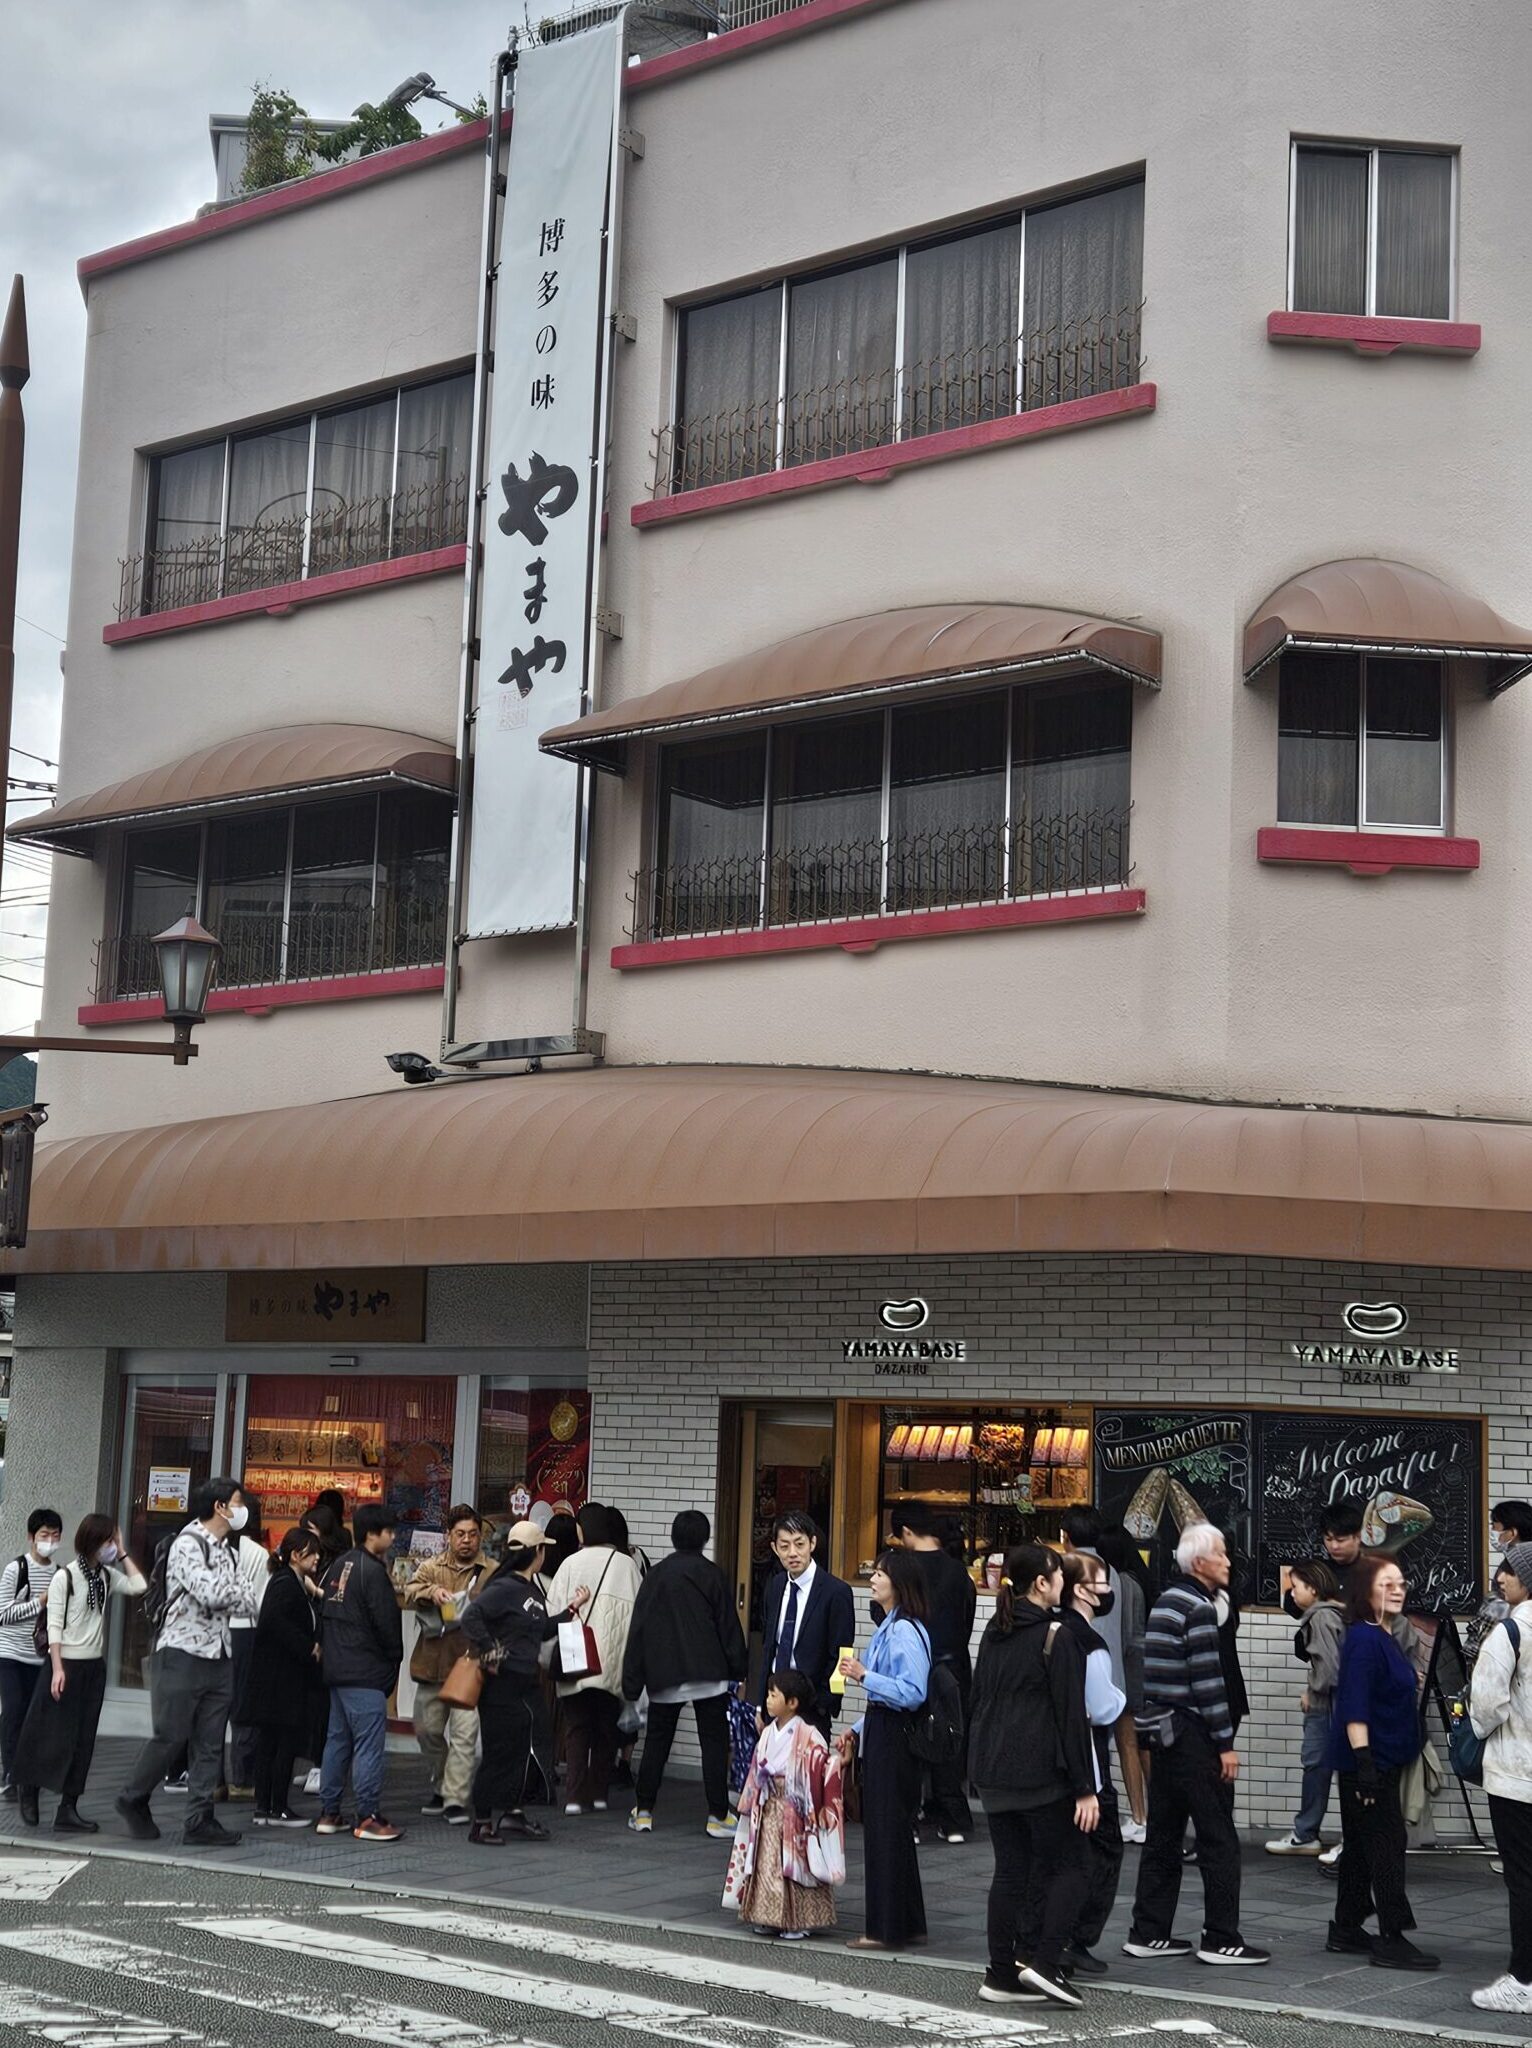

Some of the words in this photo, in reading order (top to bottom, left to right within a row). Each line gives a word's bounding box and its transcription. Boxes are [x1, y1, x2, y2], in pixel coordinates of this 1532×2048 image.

[531, 217, 566, 411] 博多の味
[497, 449, 579, 699] やまや
[313, 1280, 390, 1321] やまや
[841, 1340, 914, 1358] YAMAYA
[919, 1341, 965, 1359] BASE
[1295, 1344, 1393, 1366] YAMAYA
[1402, 1348, 1459, 1368] BASE
[1342, 1370, 1411, 1386] DAZAIFU
[1291, 1430, 1405, 1480] Welcome
